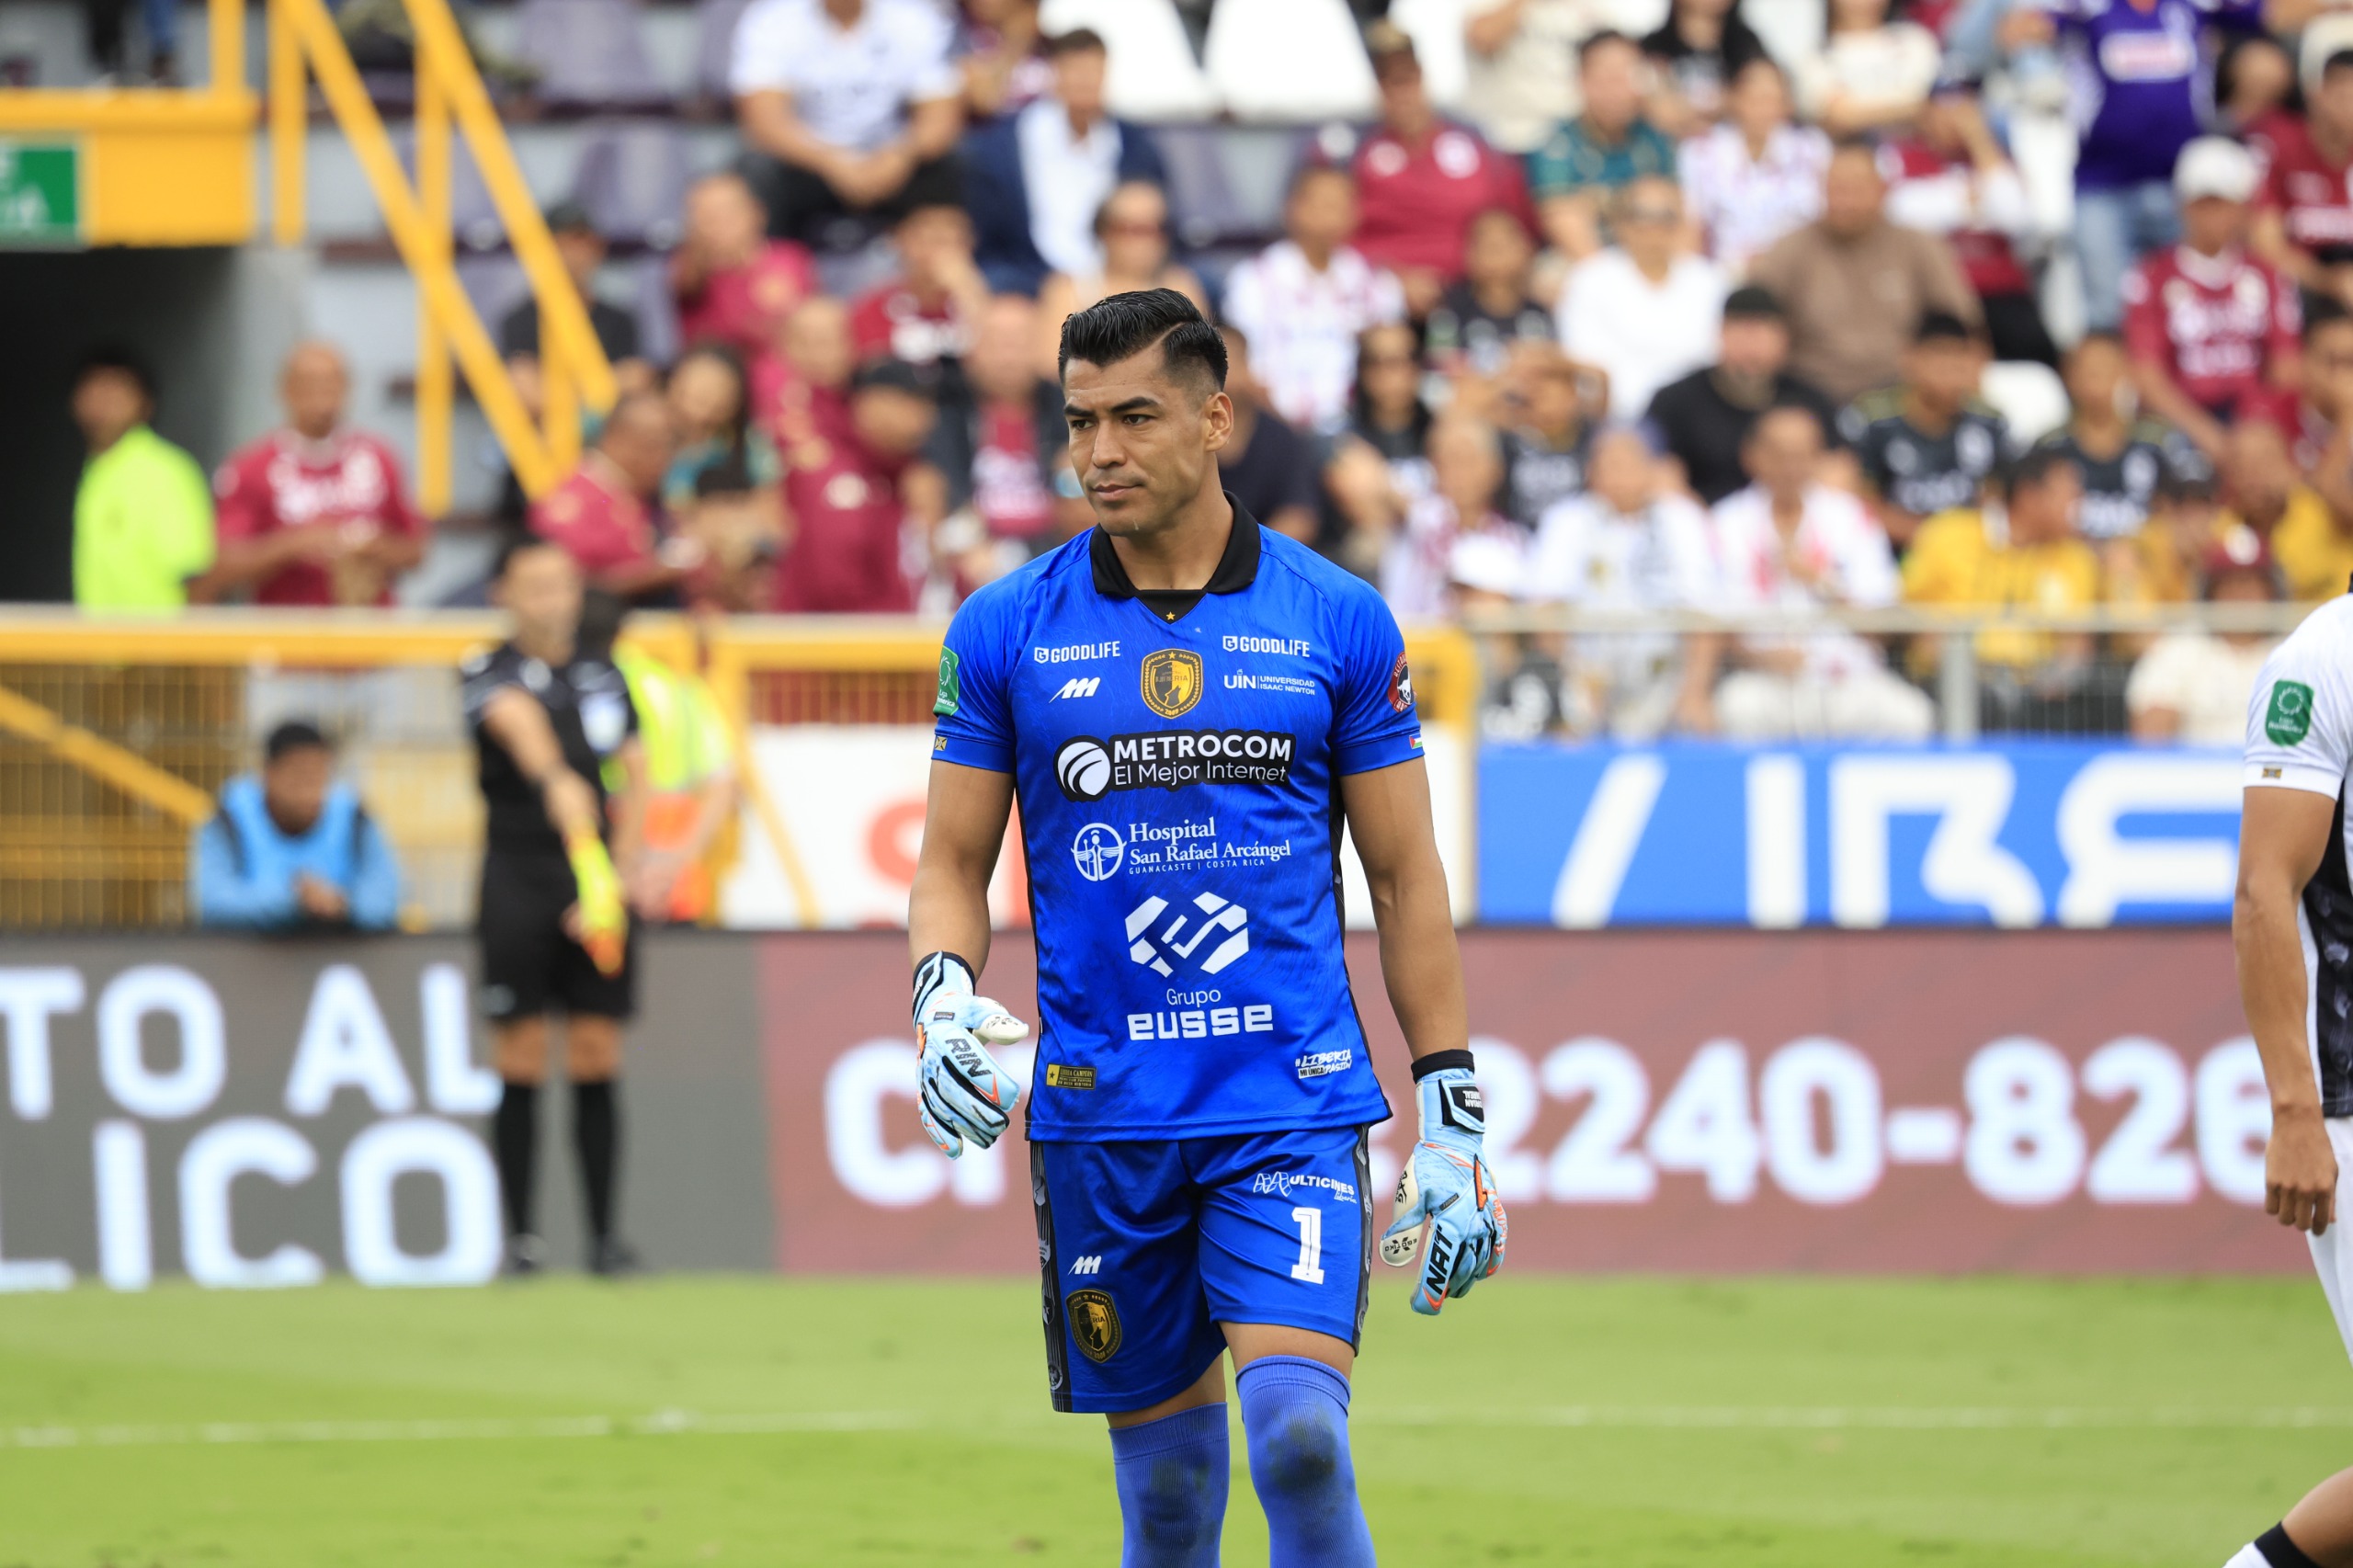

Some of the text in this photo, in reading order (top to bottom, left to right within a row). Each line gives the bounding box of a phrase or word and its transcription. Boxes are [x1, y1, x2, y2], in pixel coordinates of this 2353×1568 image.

[1051, 641, 1120, 664] GOODLIFE
[1239, 636, 1311, 658] GOODLIFE
[1259, 676, 1315, 687] UNIVERSIDAD
[1259, 683, 1315, 696] ISAAC NEWTON
[1114, 734, 1292, 764] METROCOM
[1114, 760, 1287, 786] El Mejor Internet
[1129, 816, 1217, 846] Hospital
[1130, 840, 1292, 866] San Rafael Arcángel
[1129, 863, 1192, 875] GUANACASTE
[1206, 859, 1238, 869] COSTA
[1243, 858, 1265, 867] RICA
[1166, 988, 1222, 1008] Grupo
[286, 965, 503, 1116] AL
[1291, 1207, 1324, 1285] 1
